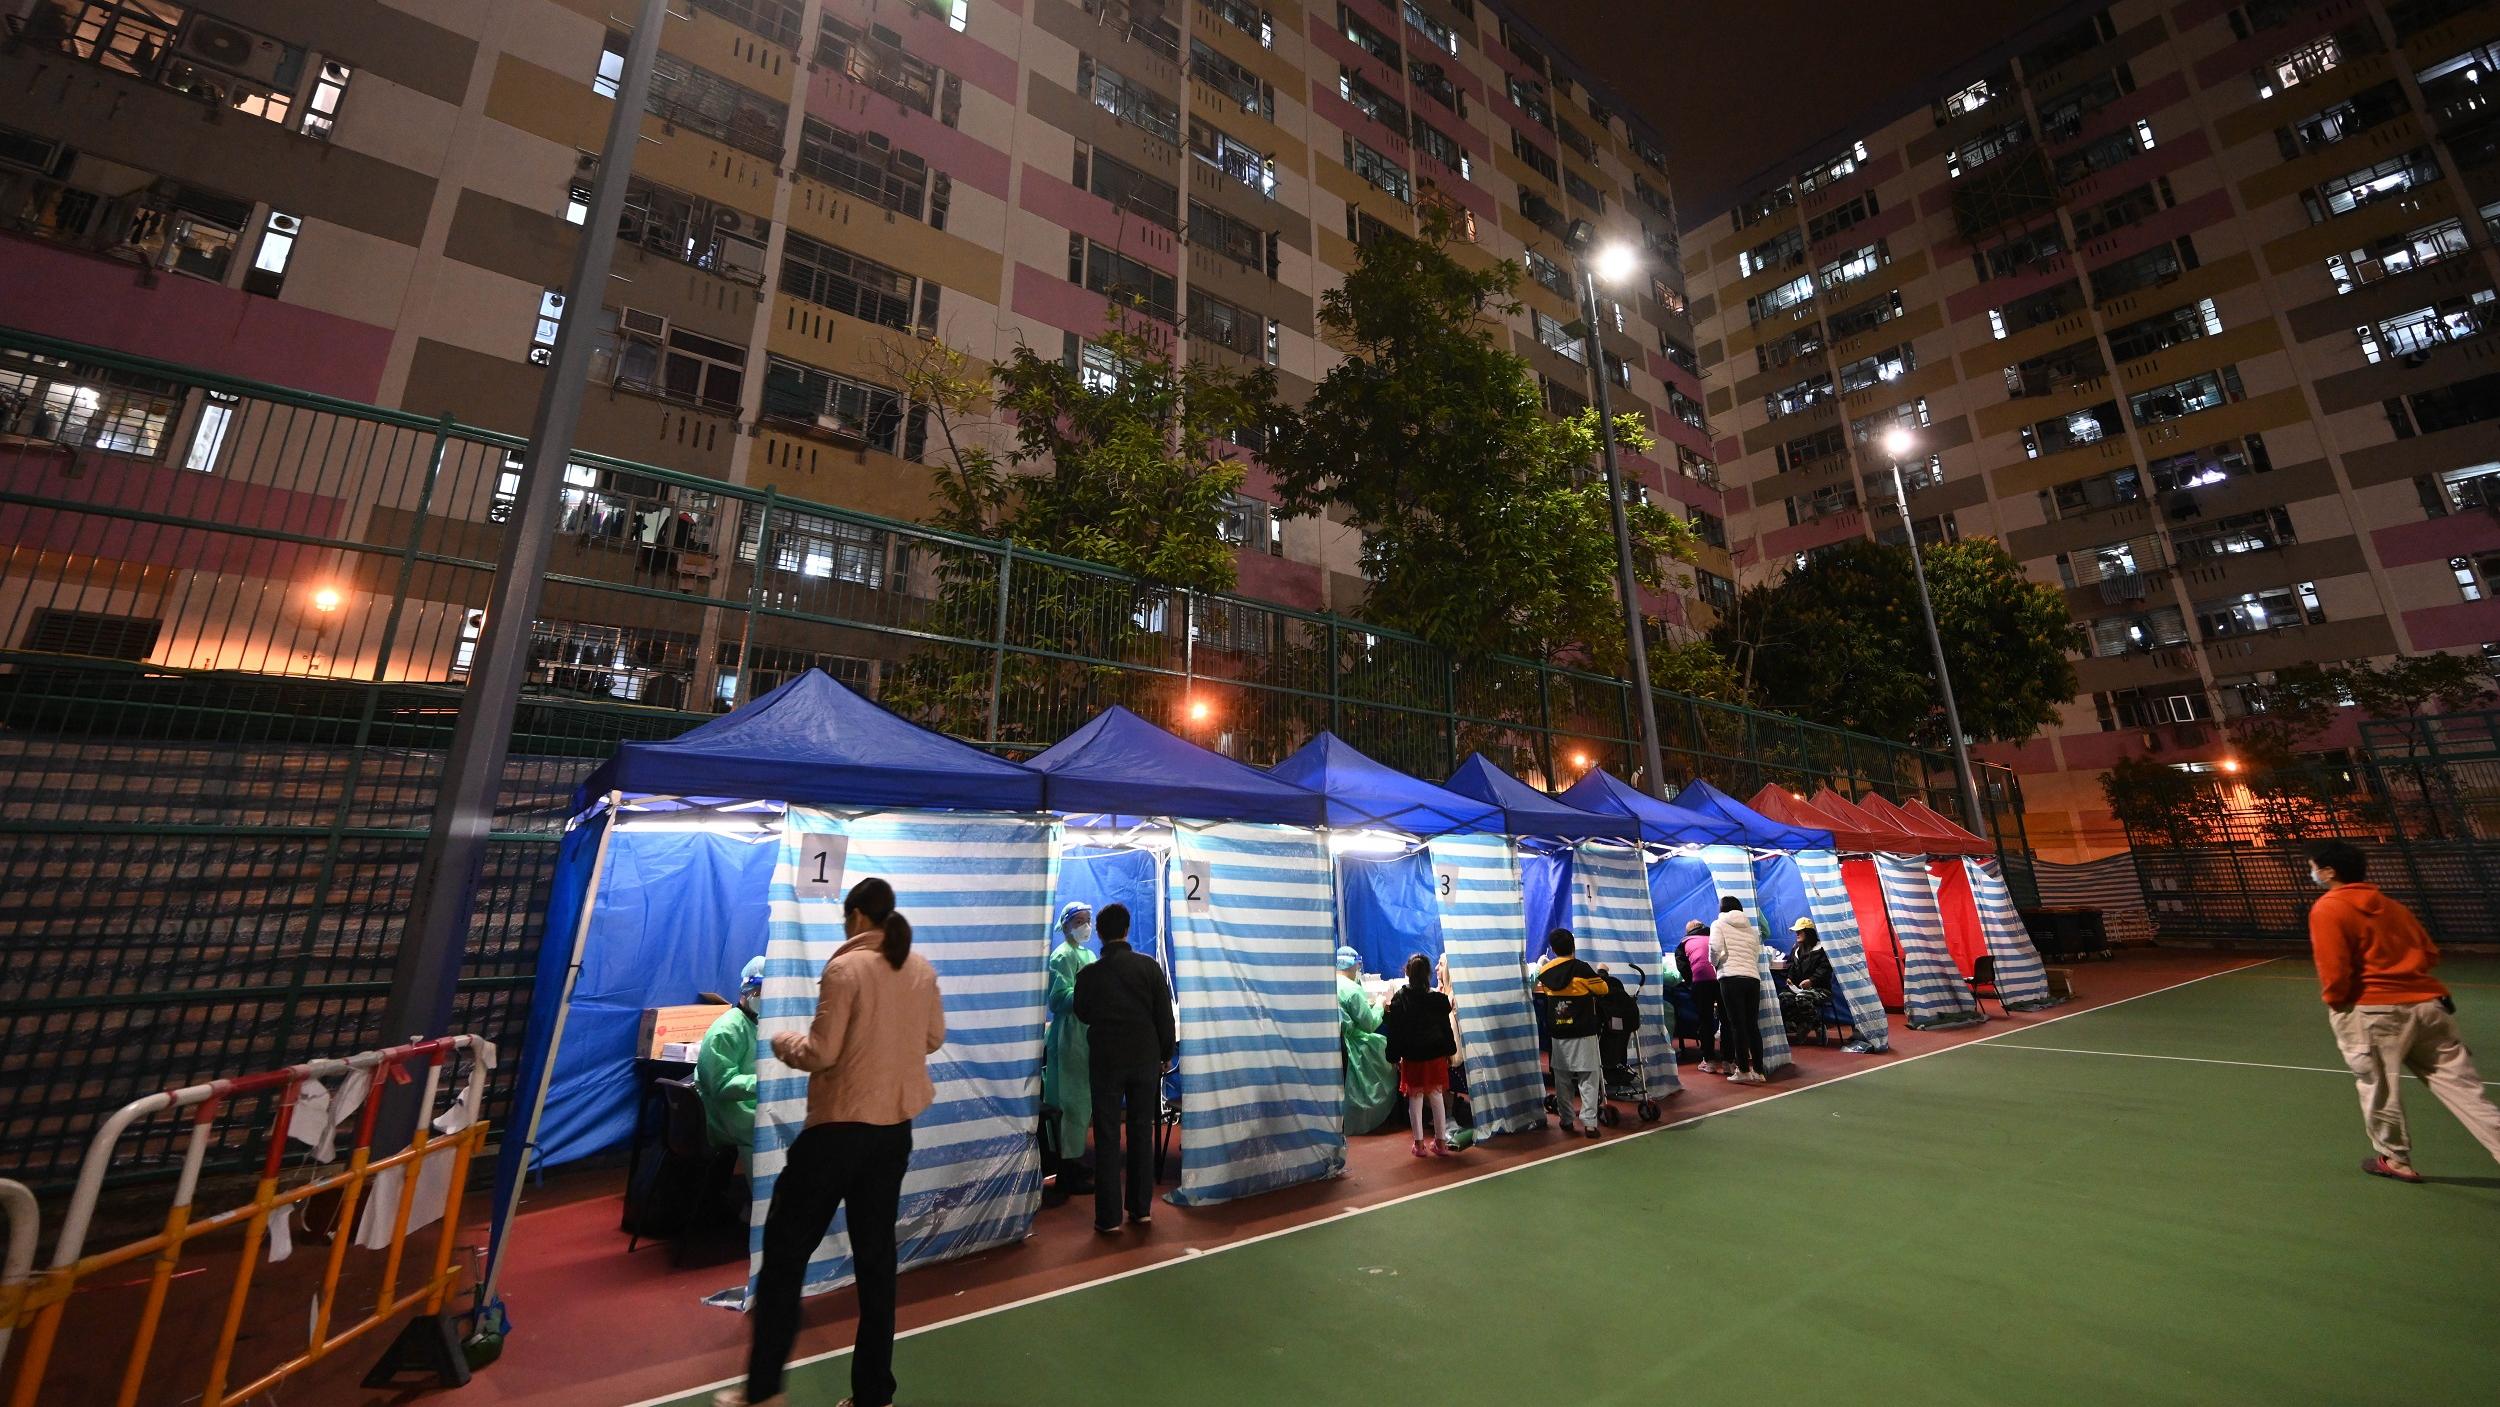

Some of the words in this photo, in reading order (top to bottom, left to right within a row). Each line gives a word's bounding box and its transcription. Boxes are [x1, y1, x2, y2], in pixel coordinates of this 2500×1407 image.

[812, 851, 829, 883] 1
[1187, 874, 1201, 901] 2
[1441, 874, 1451, 896] 3
